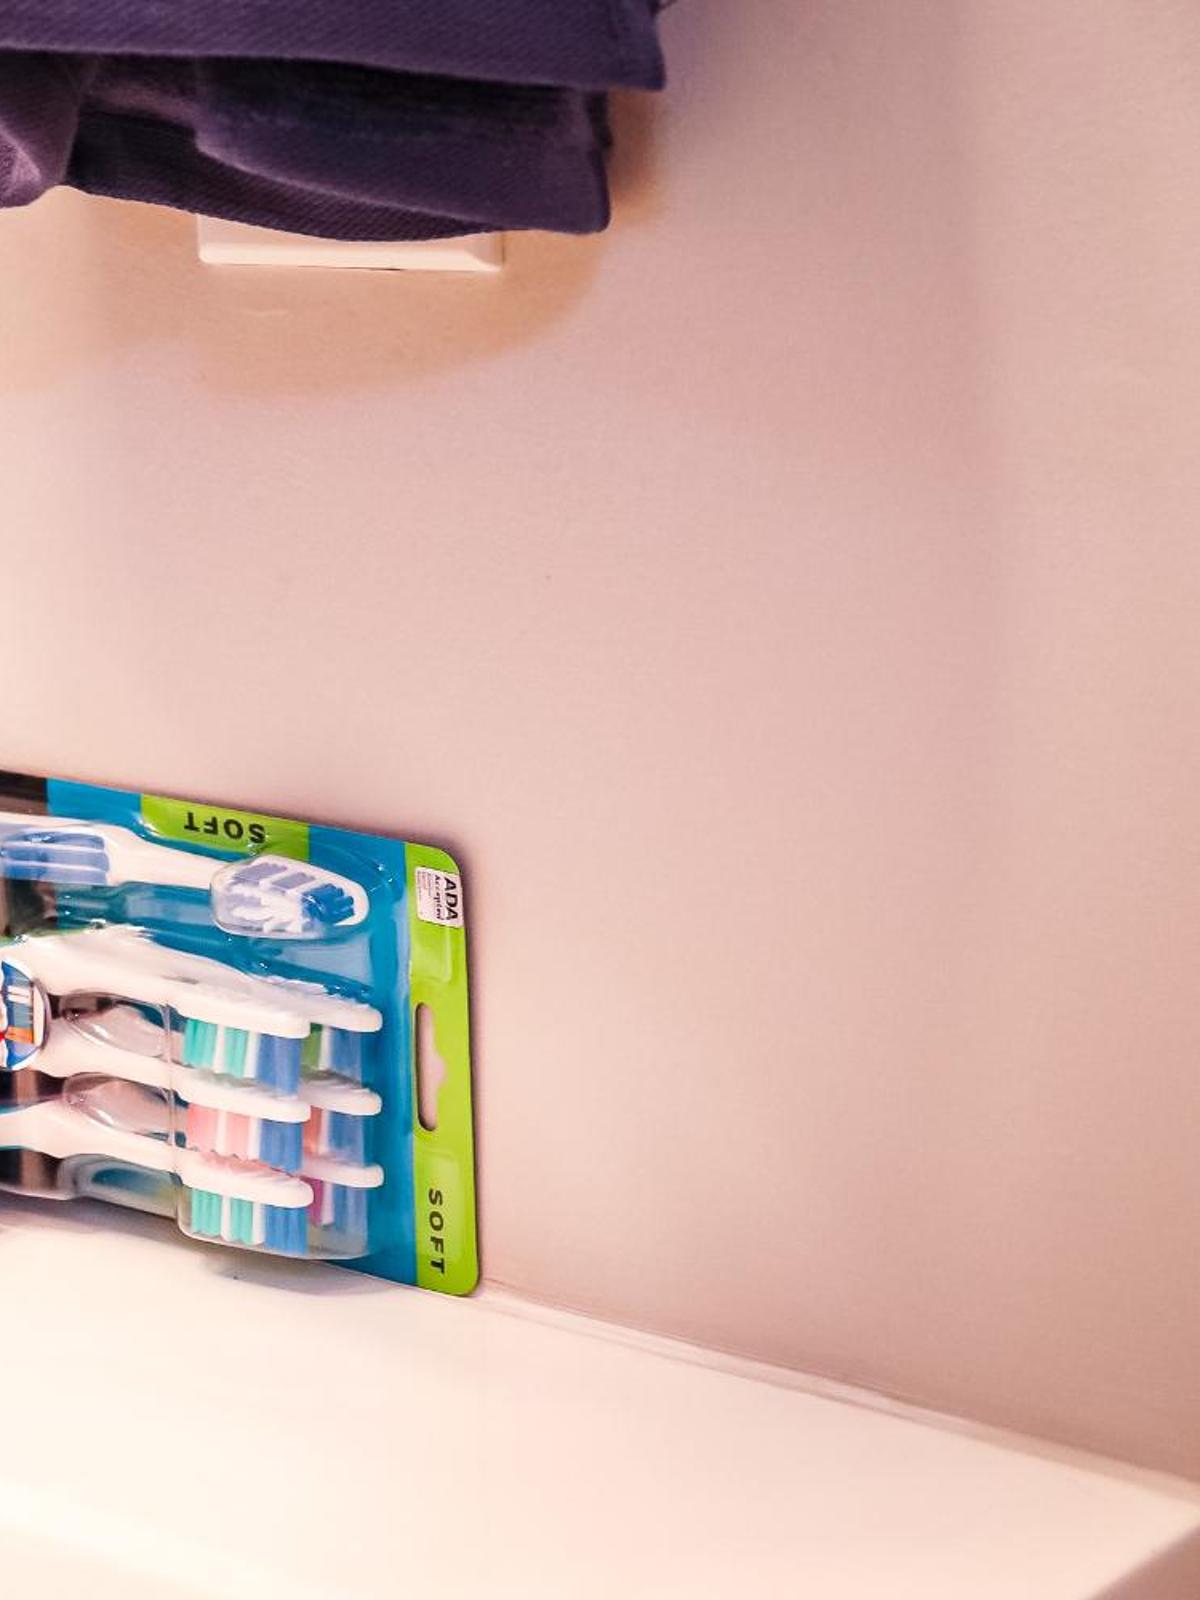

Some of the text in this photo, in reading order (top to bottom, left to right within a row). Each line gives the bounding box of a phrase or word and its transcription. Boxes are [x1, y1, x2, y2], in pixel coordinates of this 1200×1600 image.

[184, 812, 266, 844] SOFT
[443, 876, 459, 922] ADA
[428, 1188, 447, 1275] SOFT
